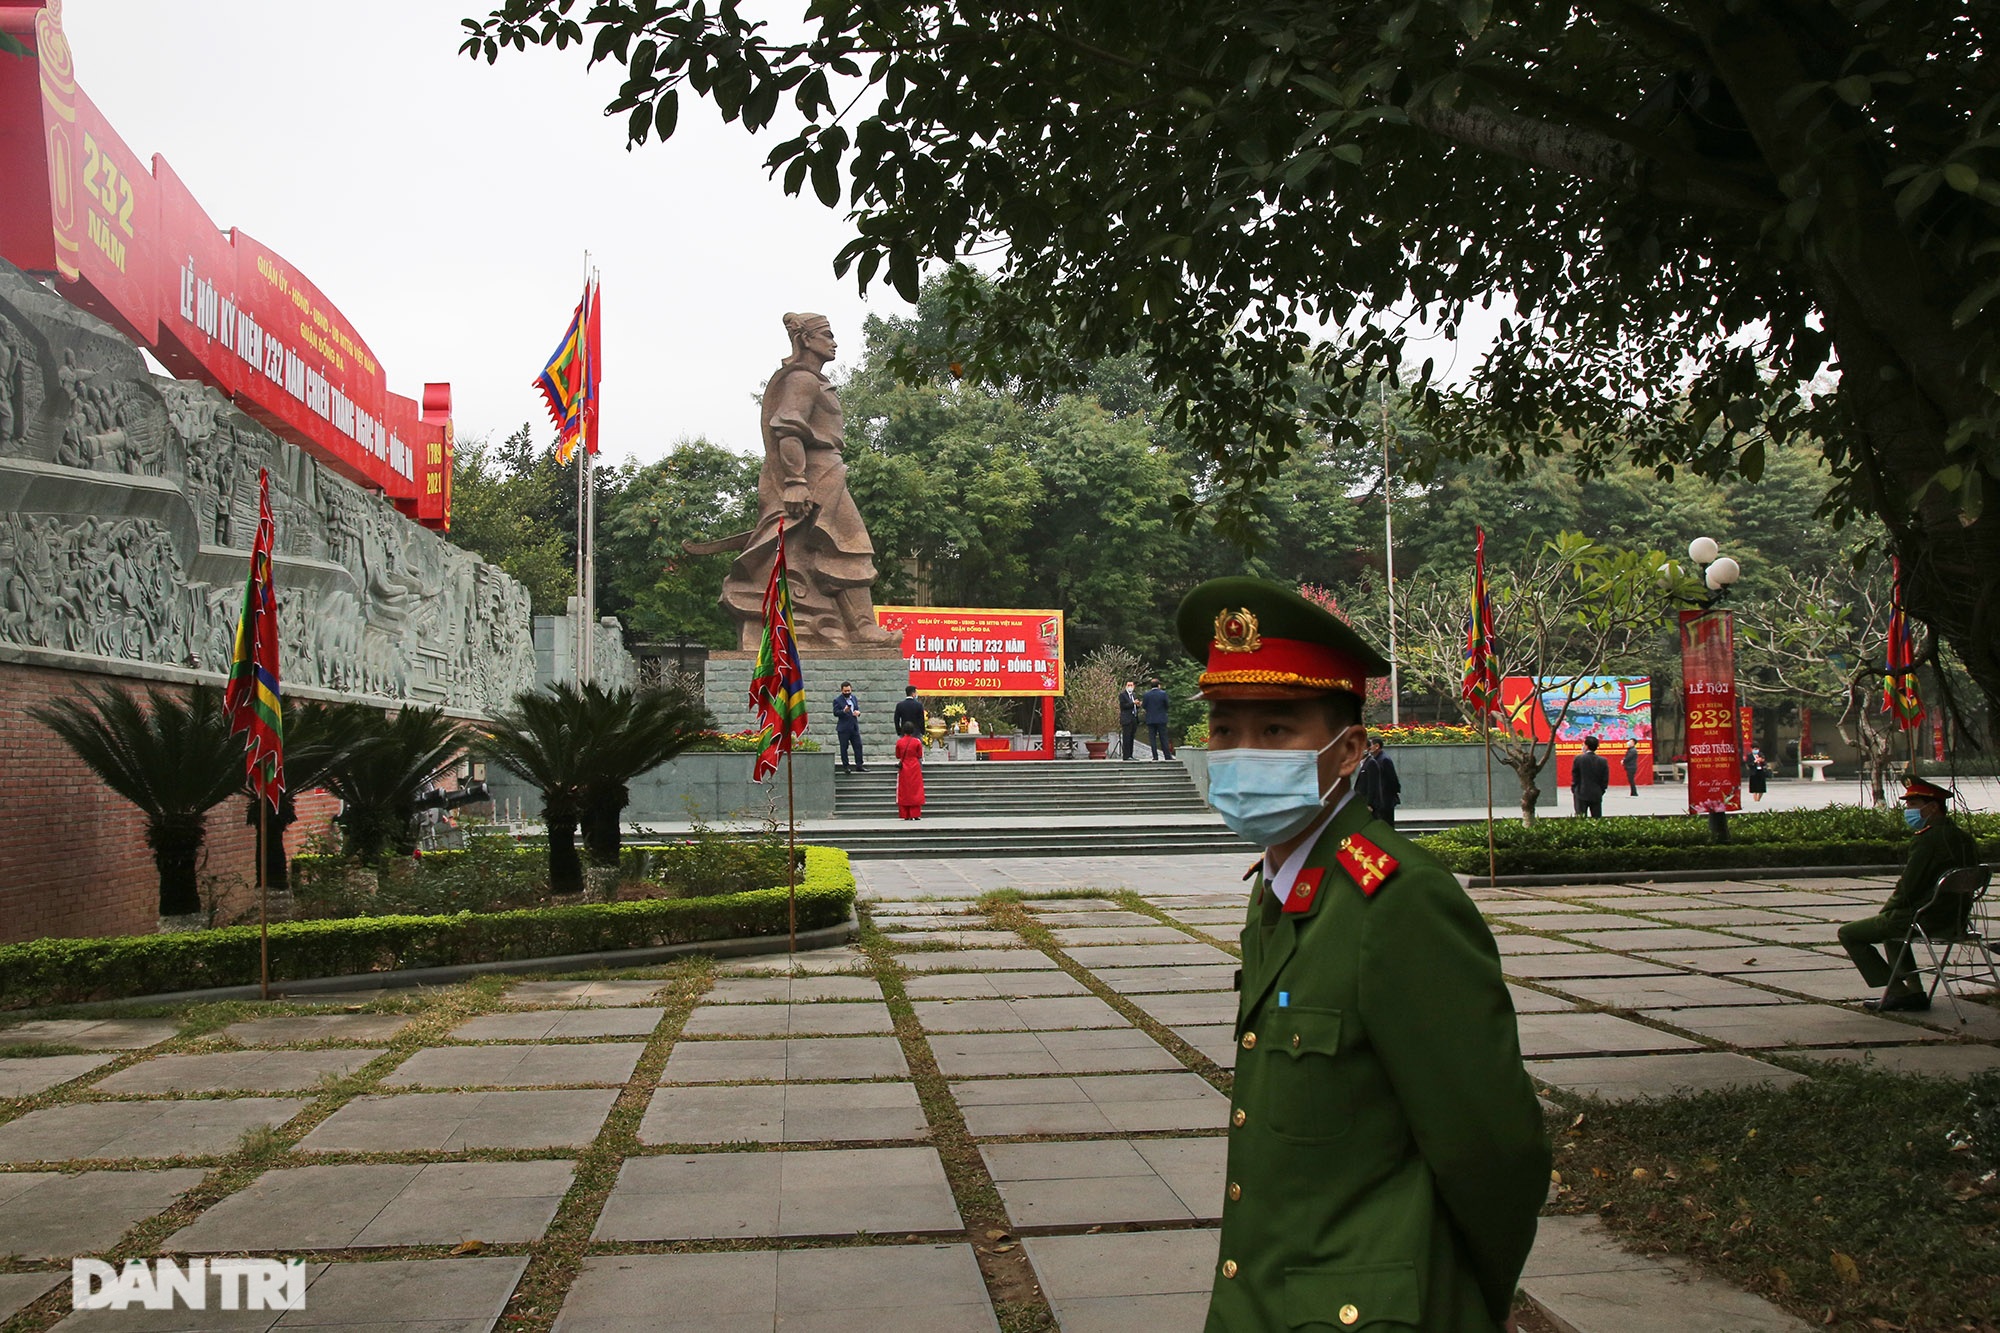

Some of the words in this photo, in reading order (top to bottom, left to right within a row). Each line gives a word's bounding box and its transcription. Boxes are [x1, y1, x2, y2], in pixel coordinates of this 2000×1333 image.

[83, 130, 134, 239] 232
[88, 207, 126, 275] NĂM
[257, 255, 278, 286] QUẬN
[363, 355, 376, 377] NAM
[180, 254, 195, 323] LỄ
[196, 276, 218, 344] HỘI
[220, 291, 237, 351] KỶ
[237, 311, 264, 374] NIỆM
[264, 332, 284, 387] 232
[285, 346, 305, 403] NĂM
[306, 364, 330, 422] CHIẾN
[331, 383, 355, 440] THẮNG
[300, 321, 318, 350] QUẬN
[426, 442, 443, 465] 1789
[426, 471, 442, 495] 2021
[917, 617, 933, 626] QUẬN
[915, 634, 926, 652] LỄ
[928, 636, 944, 654] HỘI
[946, 636, 959, 652] KỶ
[960, 637, 984, 655] NIỆM
[985, 639, 1004, 653] 232
[1005, 637, 1026, 653] NĂM
[923, 655, 954, 672] THẮNG
[955, 658, 982, 675] NGỌC
[1007, 656, 1033, 673] ĐỐNG
[1034, 659, 1048, 673] ĐA
[938, 678, 966, 689] (1789
[974, 678, 1002, 689] 2021)
[1689, 680, 1705, 694] LỄ
[1705, 681, 1729, 695] HỘI
[1689, 709, 1732, 729] 232
